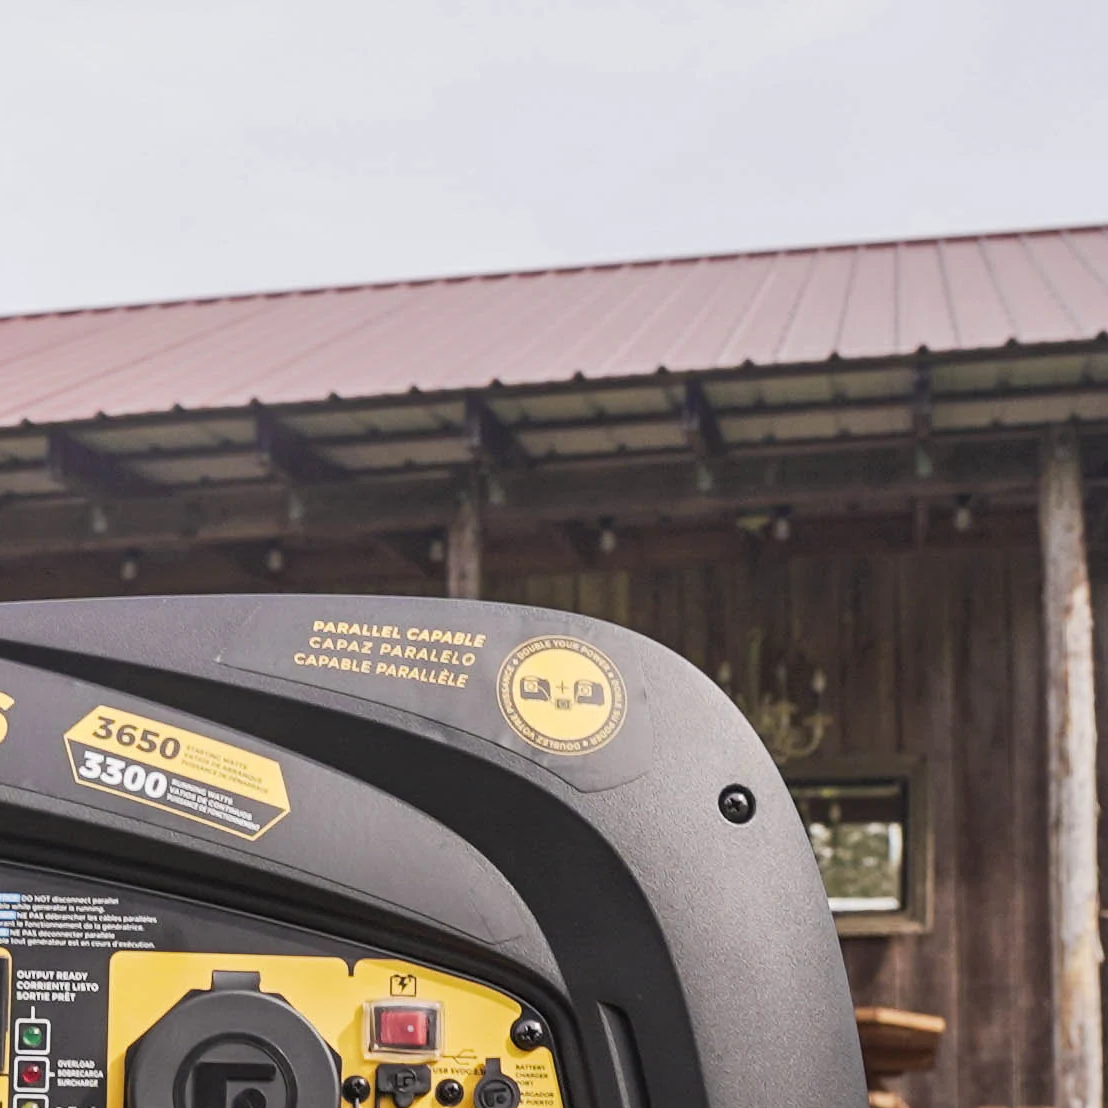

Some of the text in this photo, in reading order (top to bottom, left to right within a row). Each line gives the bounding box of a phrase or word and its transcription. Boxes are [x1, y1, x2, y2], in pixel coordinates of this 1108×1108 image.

[312, 620, 486, 648] PARALLEL CAPABLE
[309, 637, 476, 666] CAPAZ PARALELO
[517, 640, 551, 660] DOUBLE
[553, 640, 579, 651] YOUR
[294, 652, 469, 688] CAPABLE PARALLÈLE
[92, 716, 181, 759] 3650
[589, 721, 616, 746] PODER
[78, 751, 167, 798] 3300
[34, 894, 51, 903] NOT
[16, 970, 88, 981] OUTPUT READY
[16, 981, 100, 992] CORRIENTE LISTO
[16, 991, 50, 1001] SORTIE
[57, 1059, 96, 1069] OVERLOAD
[57, 1069, 104, 1079] SOBRECARGA
